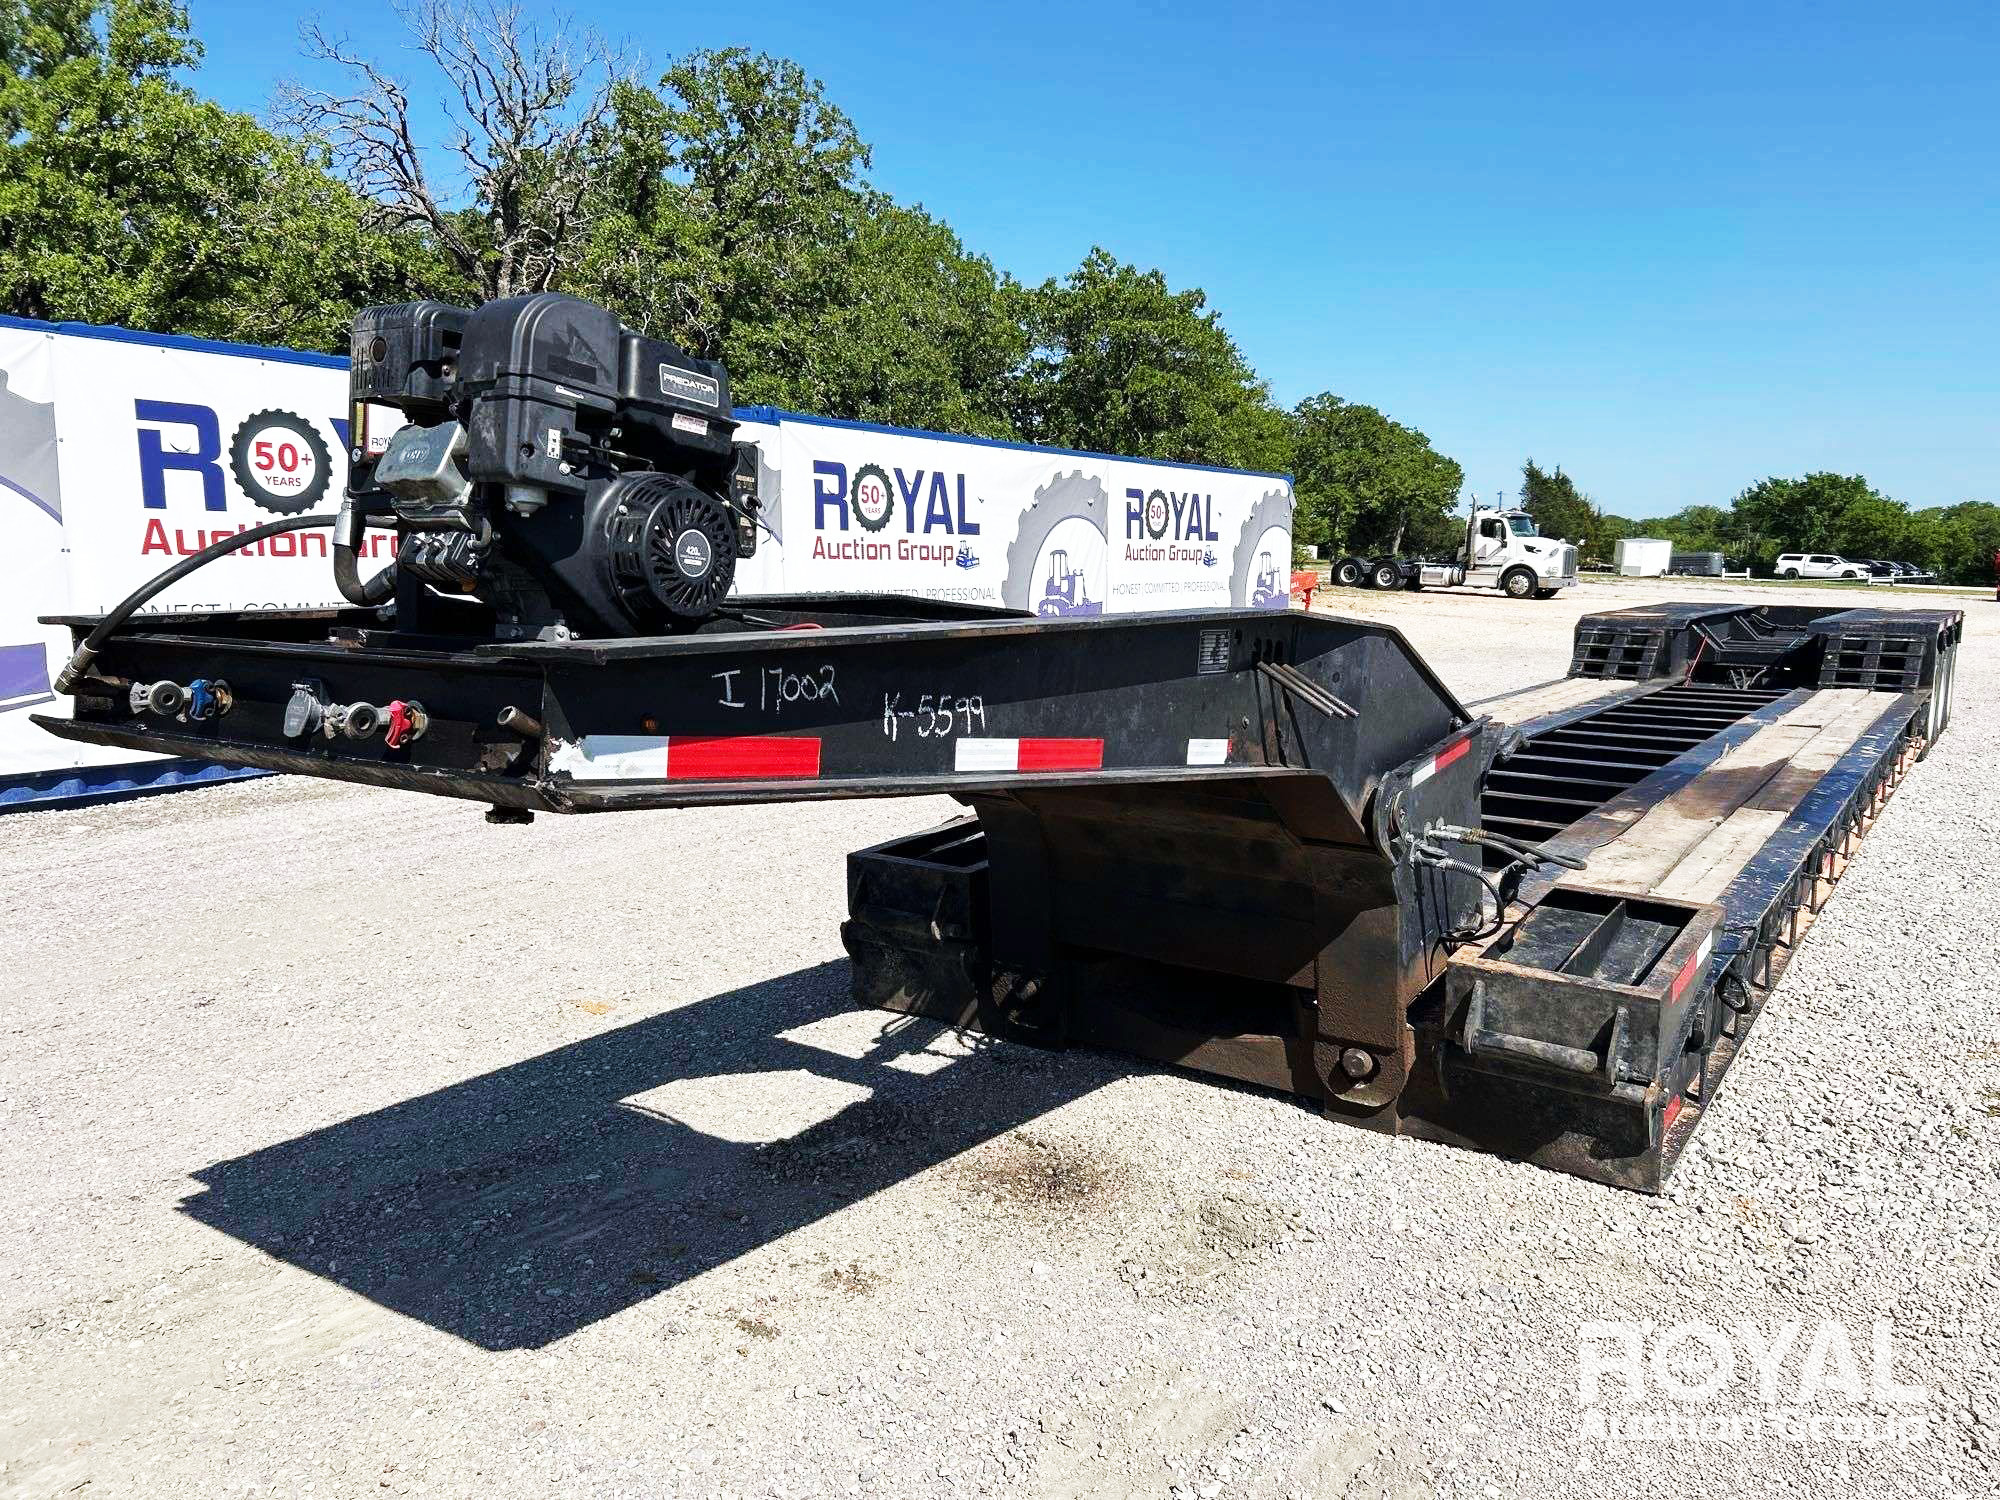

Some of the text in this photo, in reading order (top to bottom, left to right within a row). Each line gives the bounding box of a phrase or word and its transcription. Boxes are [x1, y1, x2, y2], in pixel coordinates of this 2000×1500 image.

[663, 372, 716, 395] PREDATOR
[254, 441, 313, 474] 50+
[265, 475, 302, 488] YEARS
[861, 485, 886, 505] 50+
[813, 460, 981, 536] ROYAL
[1126, 487, 1219, 541] ROYAL
[812, 535, 954, 567] Auction Group
[1125, 543, 1203, 566] Auction Group
[1113, 583, 1141, 595] HONEST
[761, 664, 840, 714] 17002
[883, 691, 986, 742] K-5599
